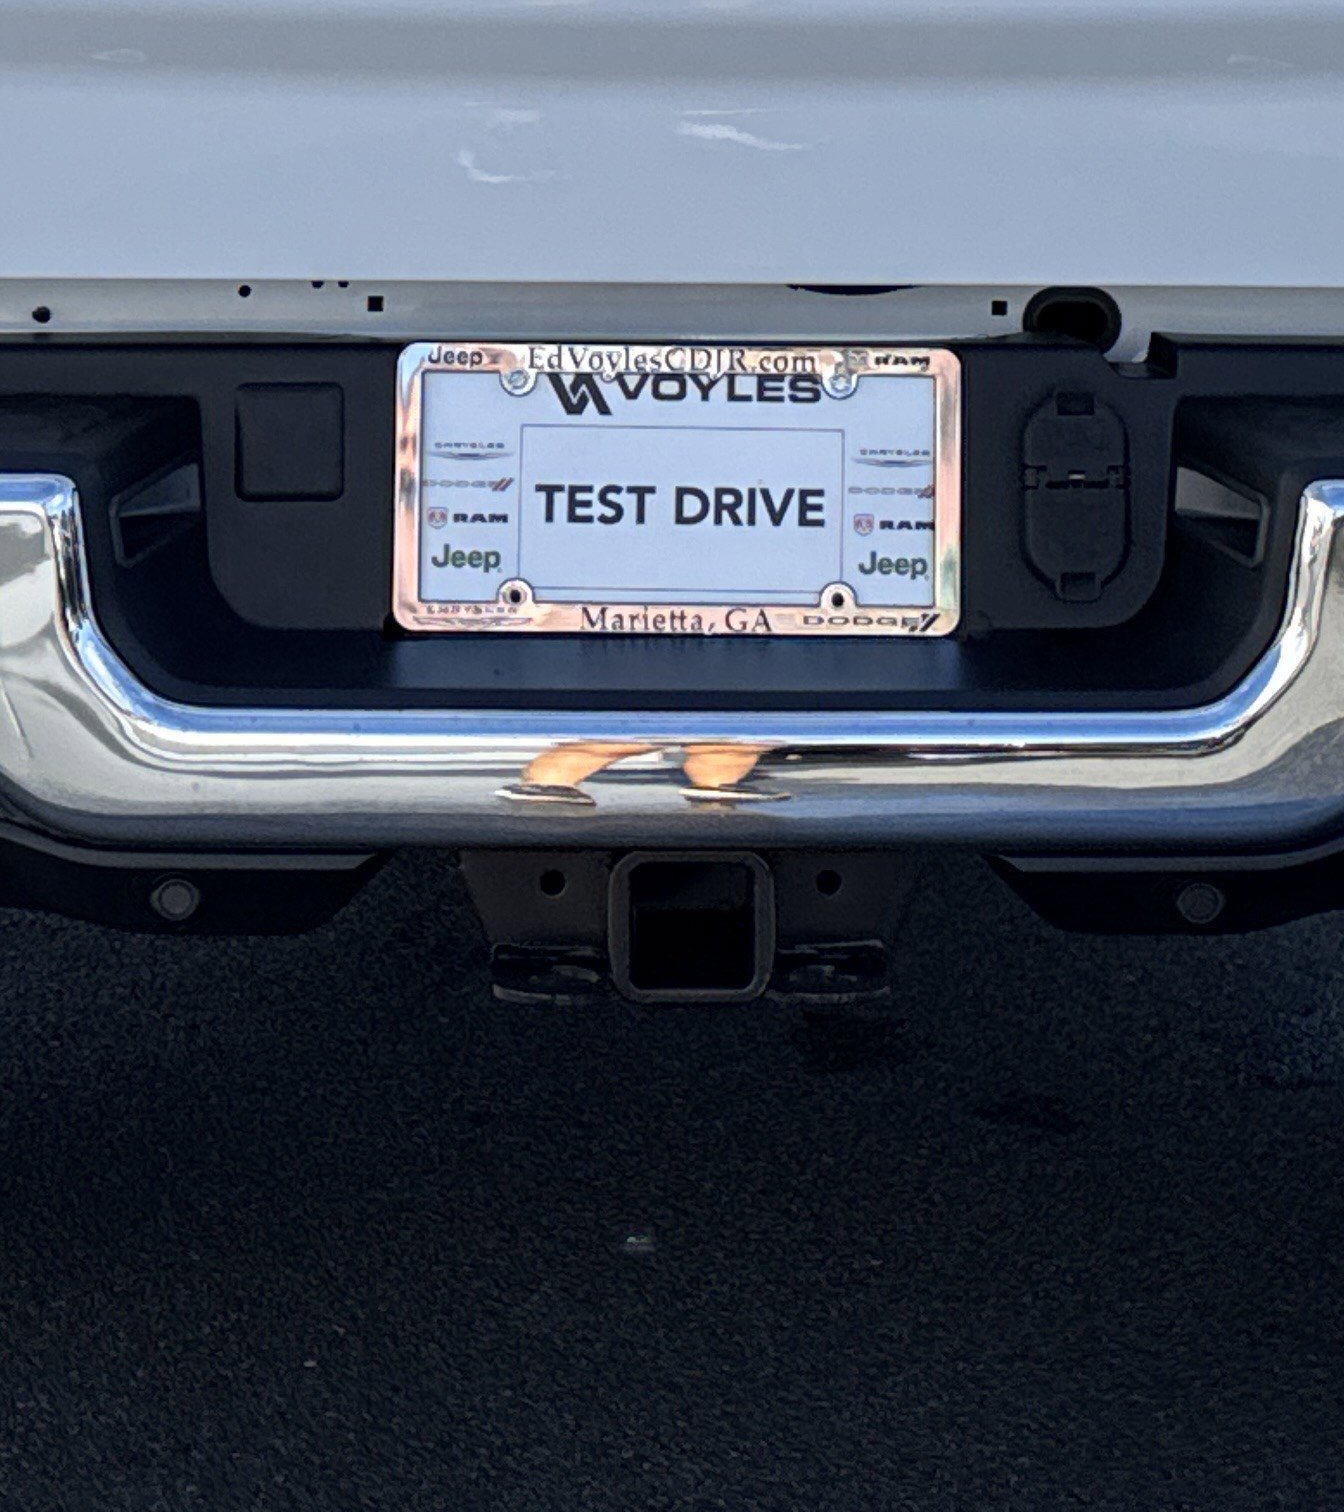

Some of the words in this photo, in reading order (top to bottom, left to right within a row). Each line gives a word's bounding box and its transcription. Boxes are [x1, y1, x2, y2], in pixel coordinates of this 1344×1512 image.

[428, 346, 484, 368] Jeep
[527, 346, 817, 380] EdVoylesCDJR.com
[616, 374, 822, 403] VOYLES
[453, 512, 509, 523] RAM
[535, 484, 656, 525] TEST
[674, 486, 826, 527] DRIVE
[879, 519, 934, 530] RAM
[431, 544, 500, 573] Jeep
[858, 550, 928, 580] Jeep
[580, 605, 714, 633] Marietta,
[724, 608, 772, 632] GA
